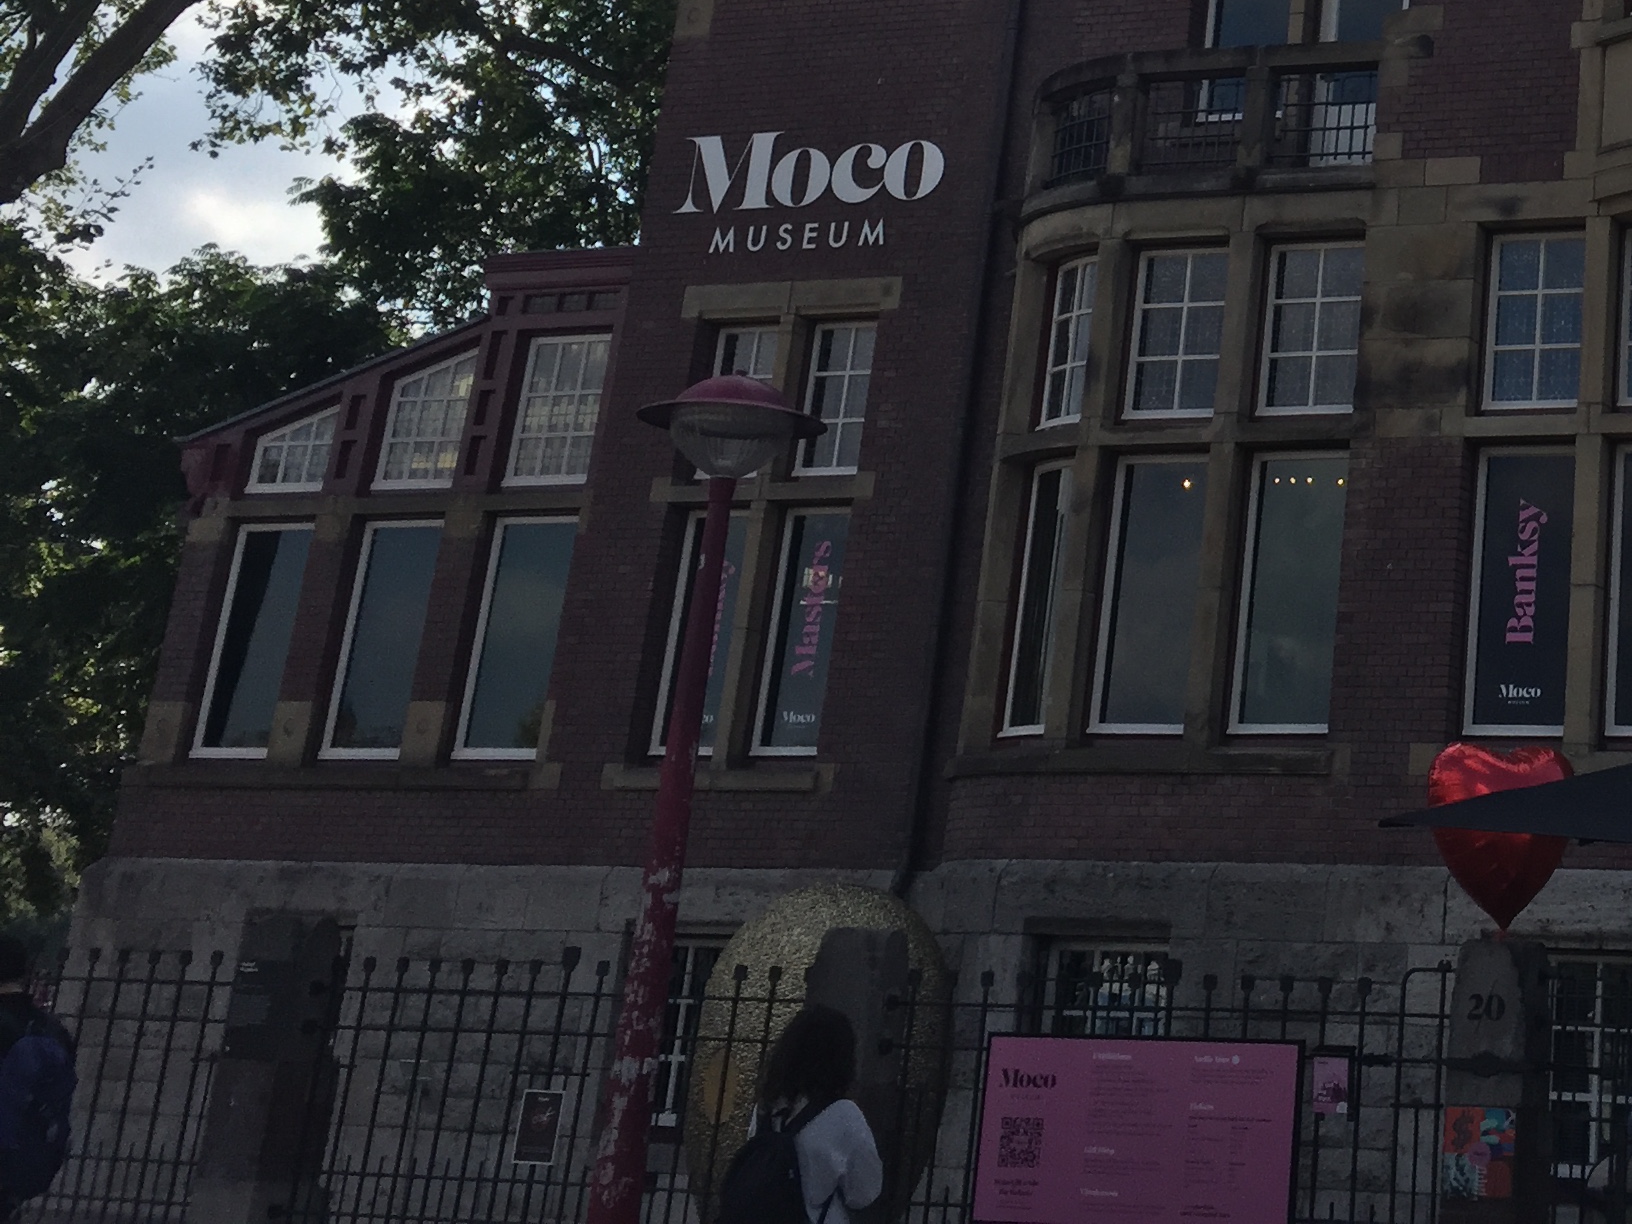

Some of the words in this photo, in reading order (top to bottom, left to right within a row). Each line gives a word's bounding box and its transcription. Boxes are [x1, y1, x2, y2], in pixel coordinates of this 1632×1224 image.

[672, 131, 945, 214] Moco
[708, 217, 885, 254] MUSEUM
[1505, 498, 1548, 645] Banksy
[1498, 683, 1541, 698] Moco
[782, 710, 816, 723] Moco
[1467, 993, 1506, 1021] 20
[999, 1067, 1057, 1089] Moco
